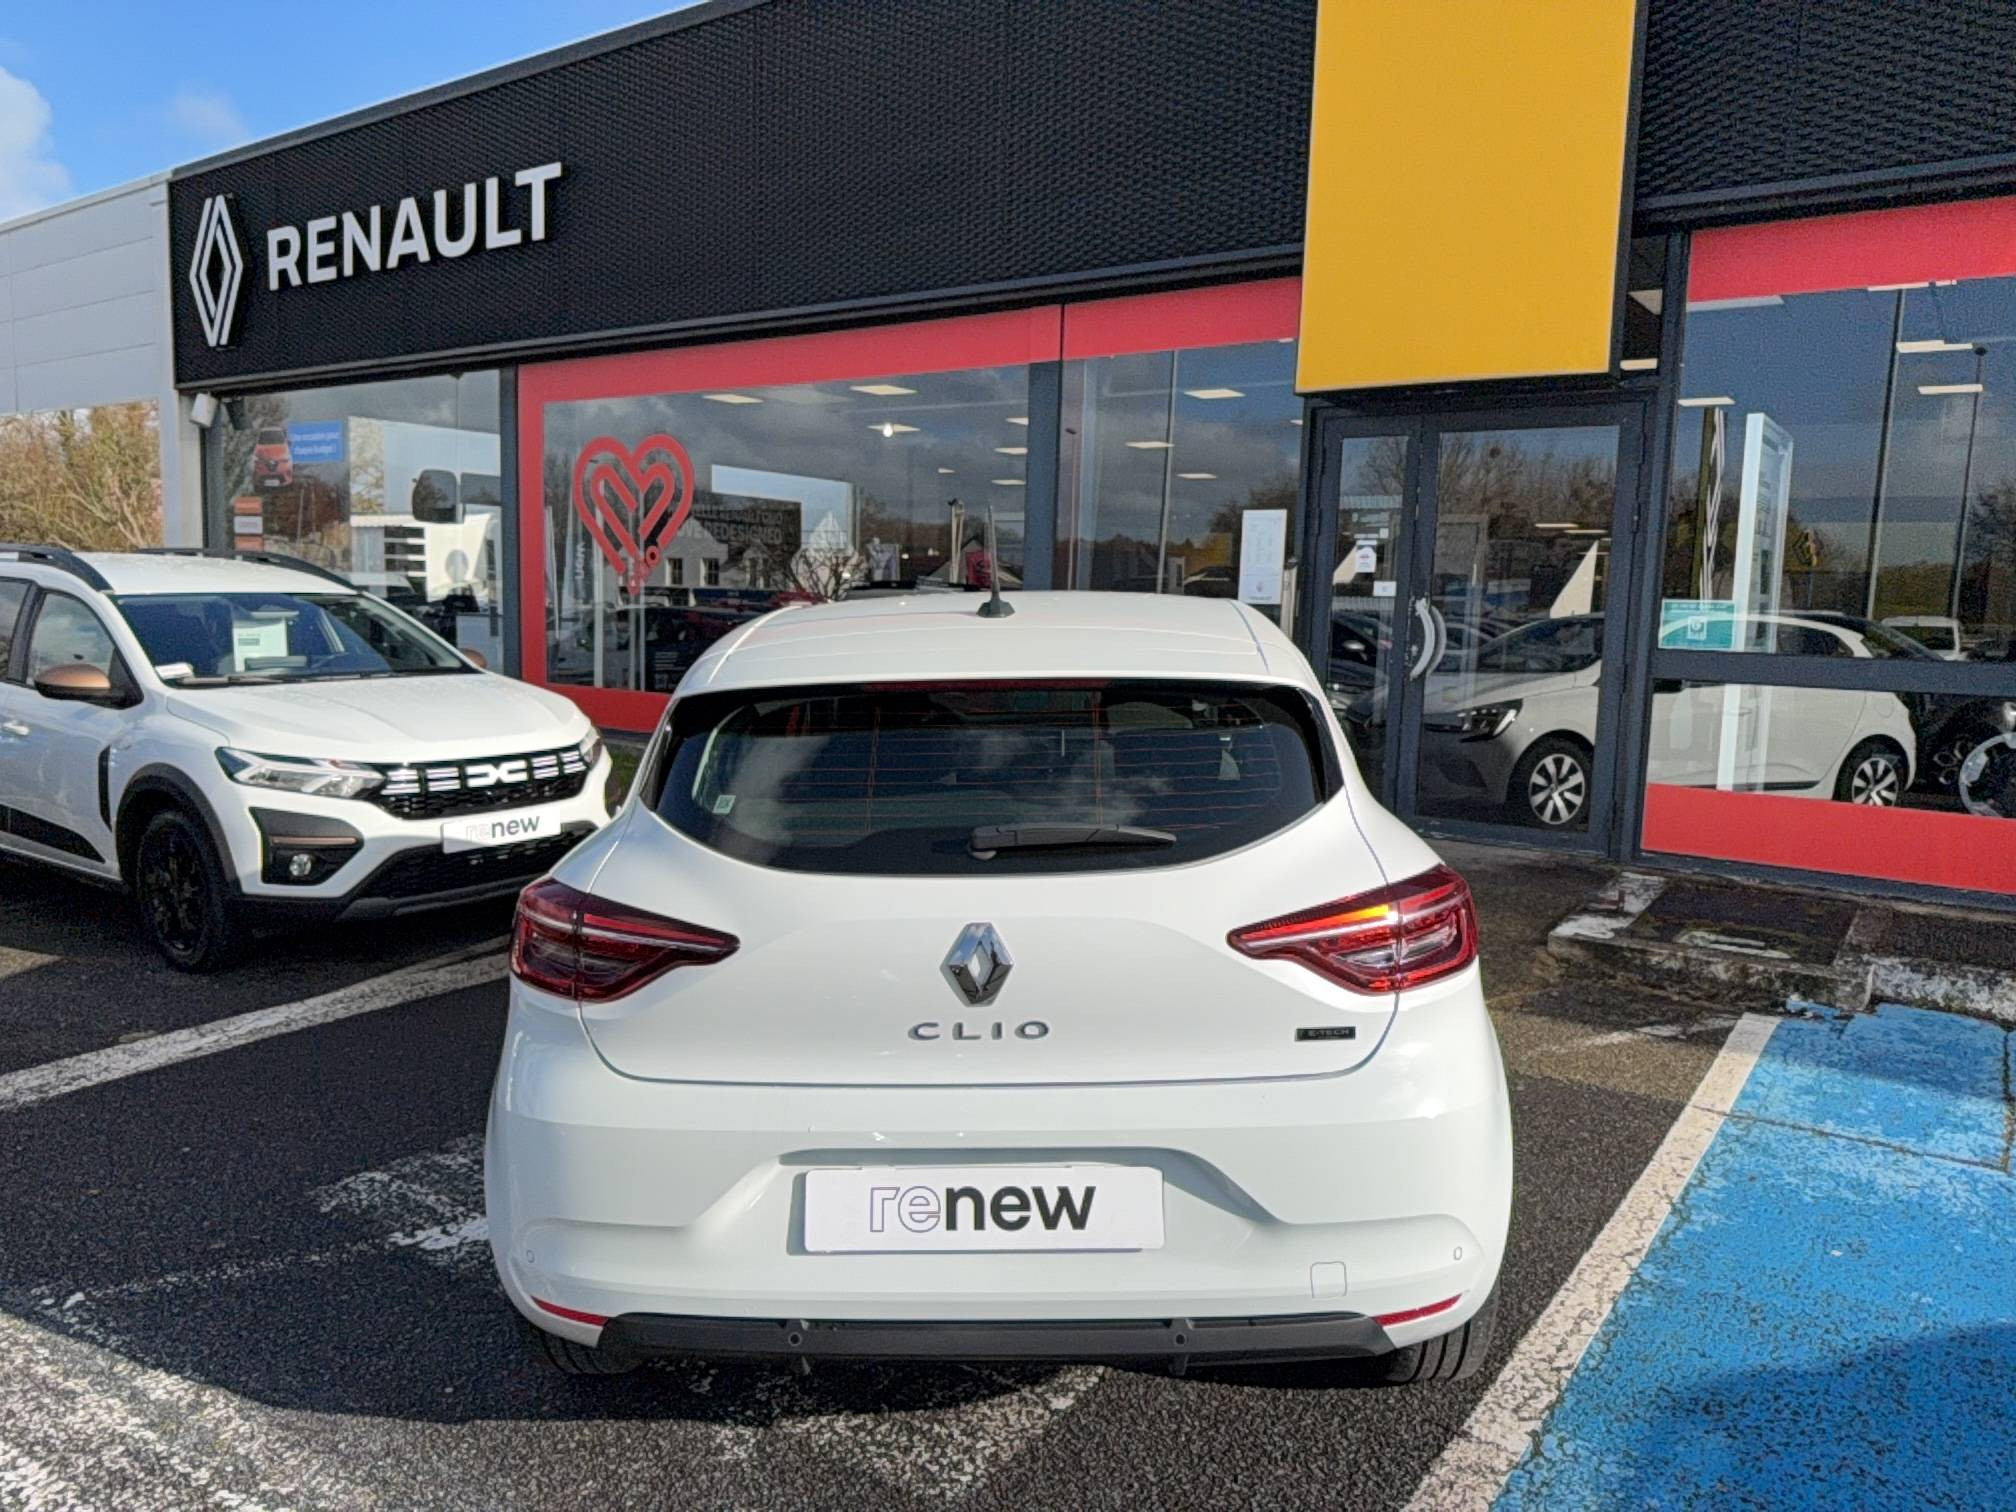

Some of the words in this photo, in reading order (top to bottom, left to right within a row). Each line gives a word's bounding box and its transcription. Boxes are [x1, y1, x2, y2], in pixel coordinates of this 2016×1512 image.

[267, 161, 562, 291] RENAULT
[908, 1020, 1049, 1041] CLIO
[1308, 1029, 1350, 1037] E-TECH
[869, 1185, 1097, 1233] renew
